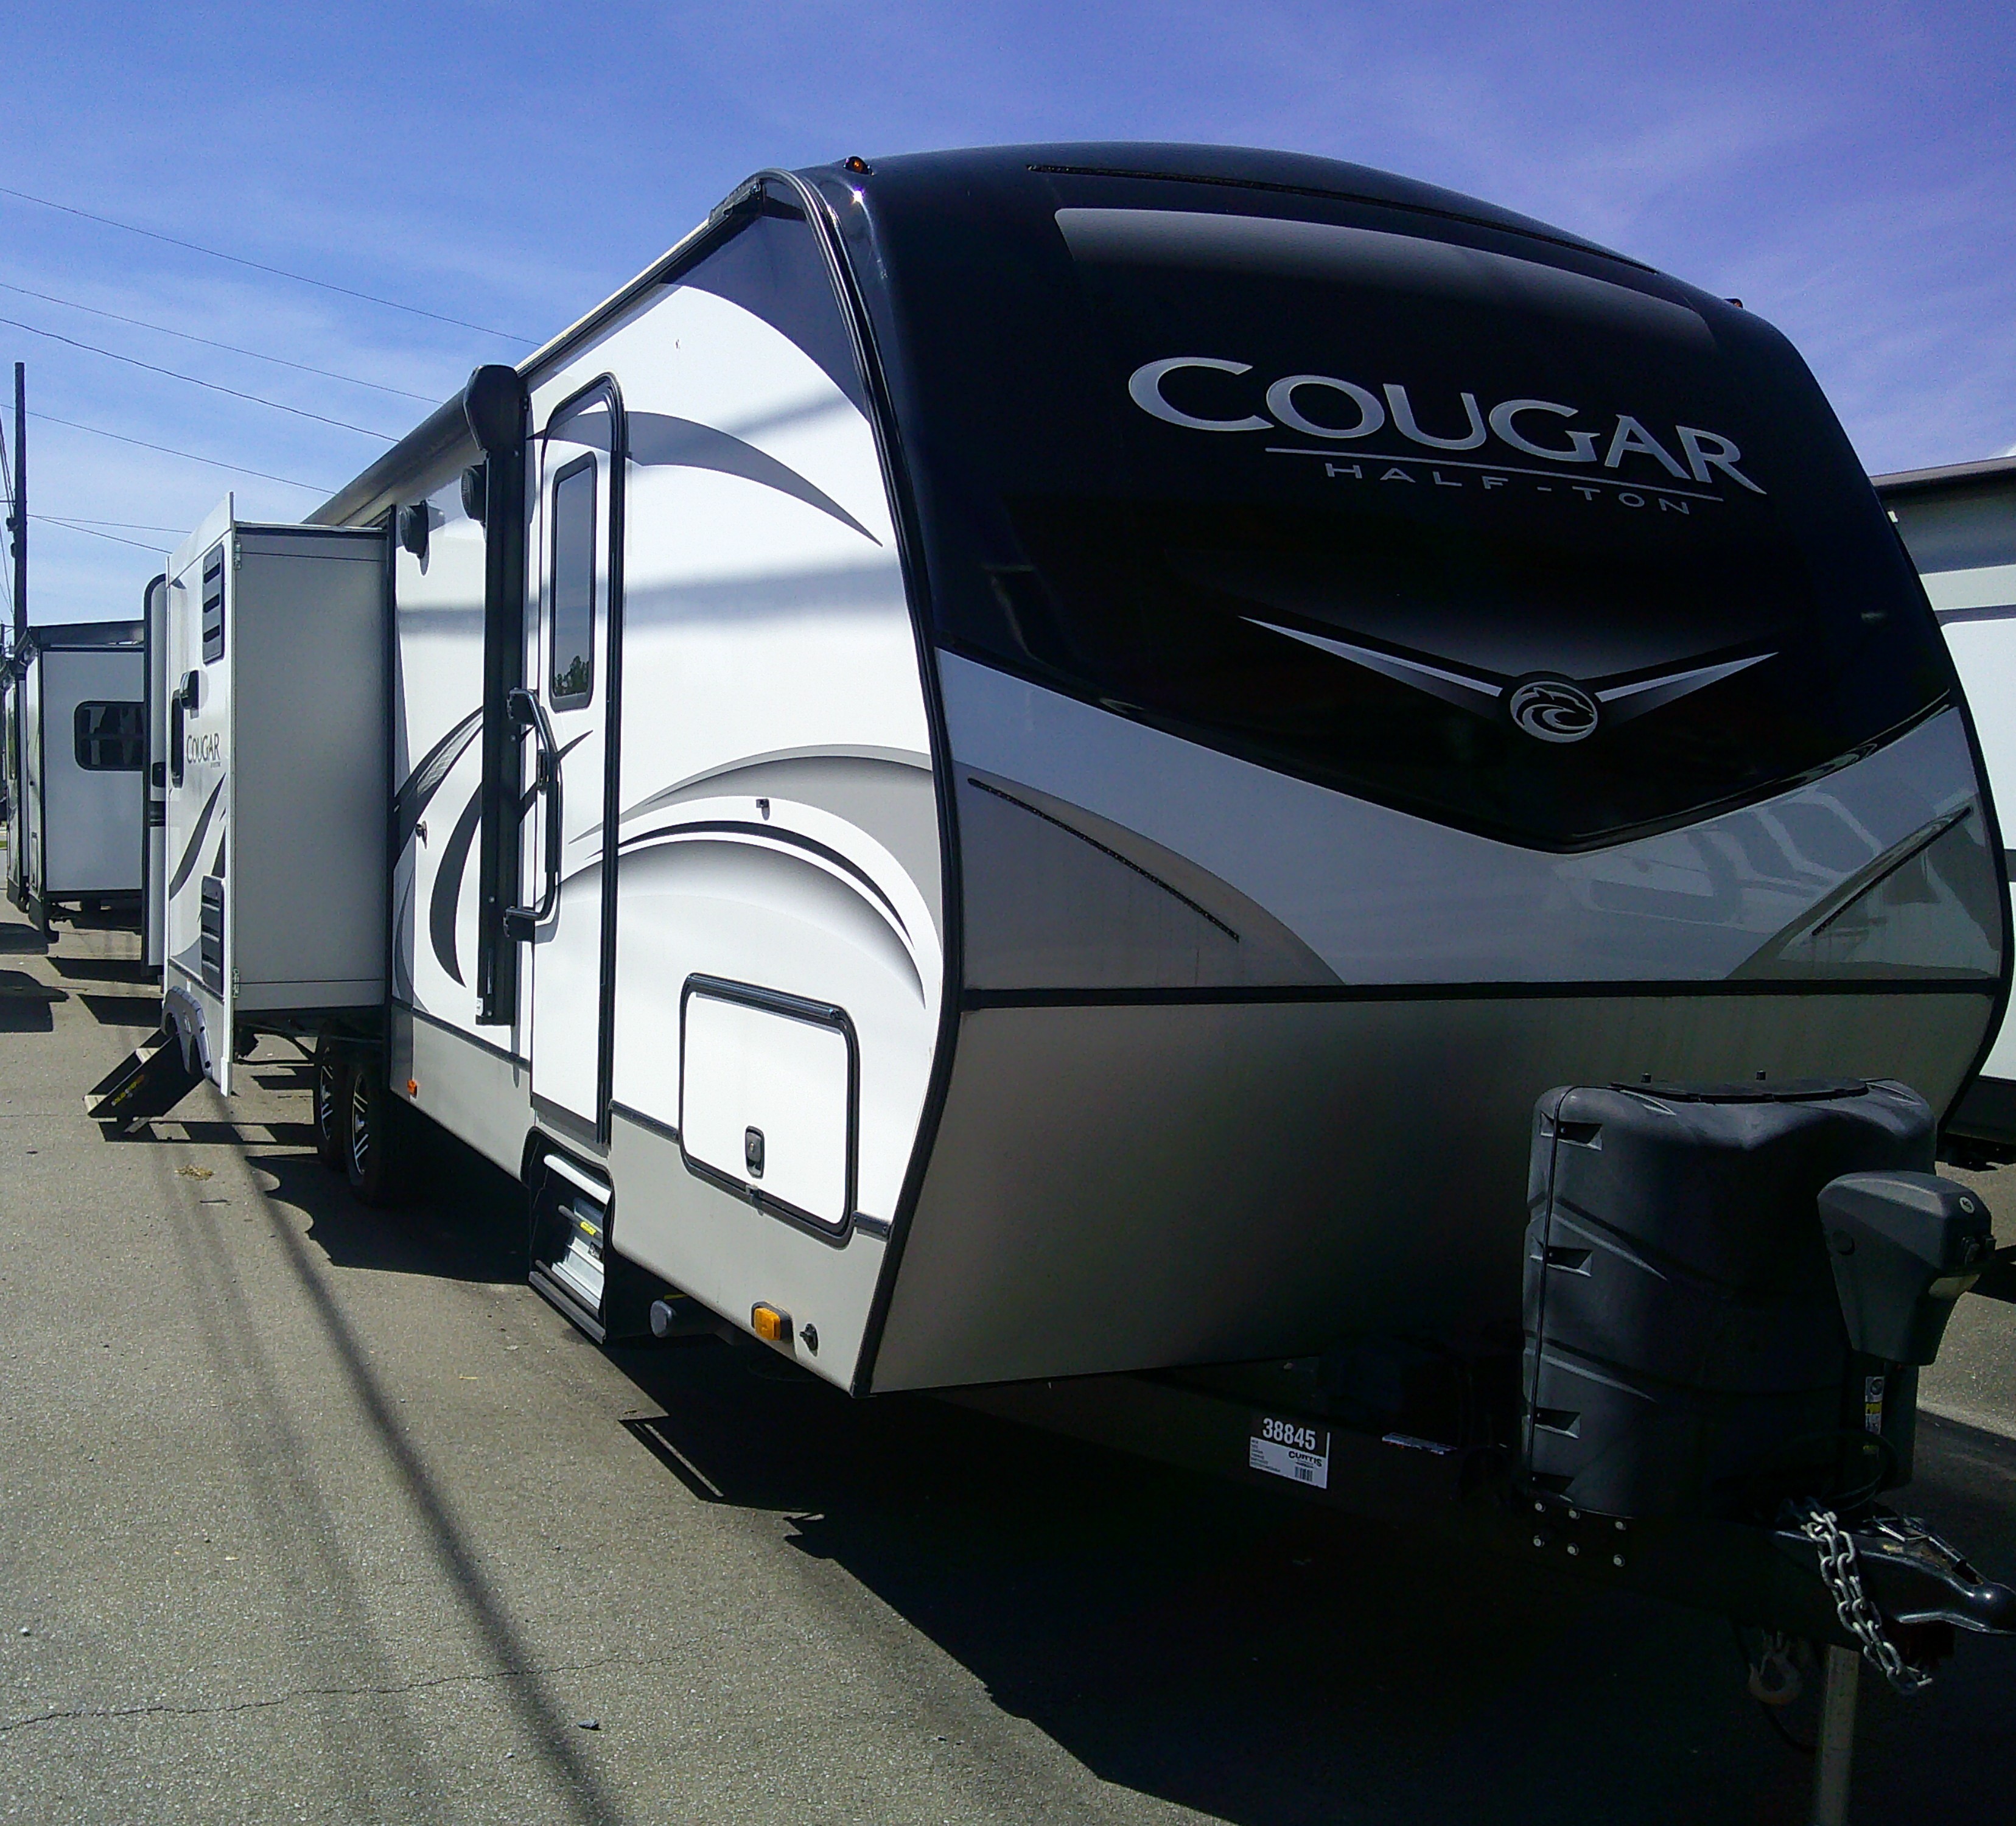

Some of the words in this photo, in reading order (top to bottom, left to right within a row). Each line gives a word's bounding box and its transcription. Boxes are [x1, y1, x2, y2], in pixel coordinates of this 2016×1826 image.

[1129, 356, 1767, 495] COUGAR
[186, 733, 220, 763] COUGAR
[1262, 1418, 1316, 1450] 38845
[1288, 1450, 1323, 1467] CURTIS
